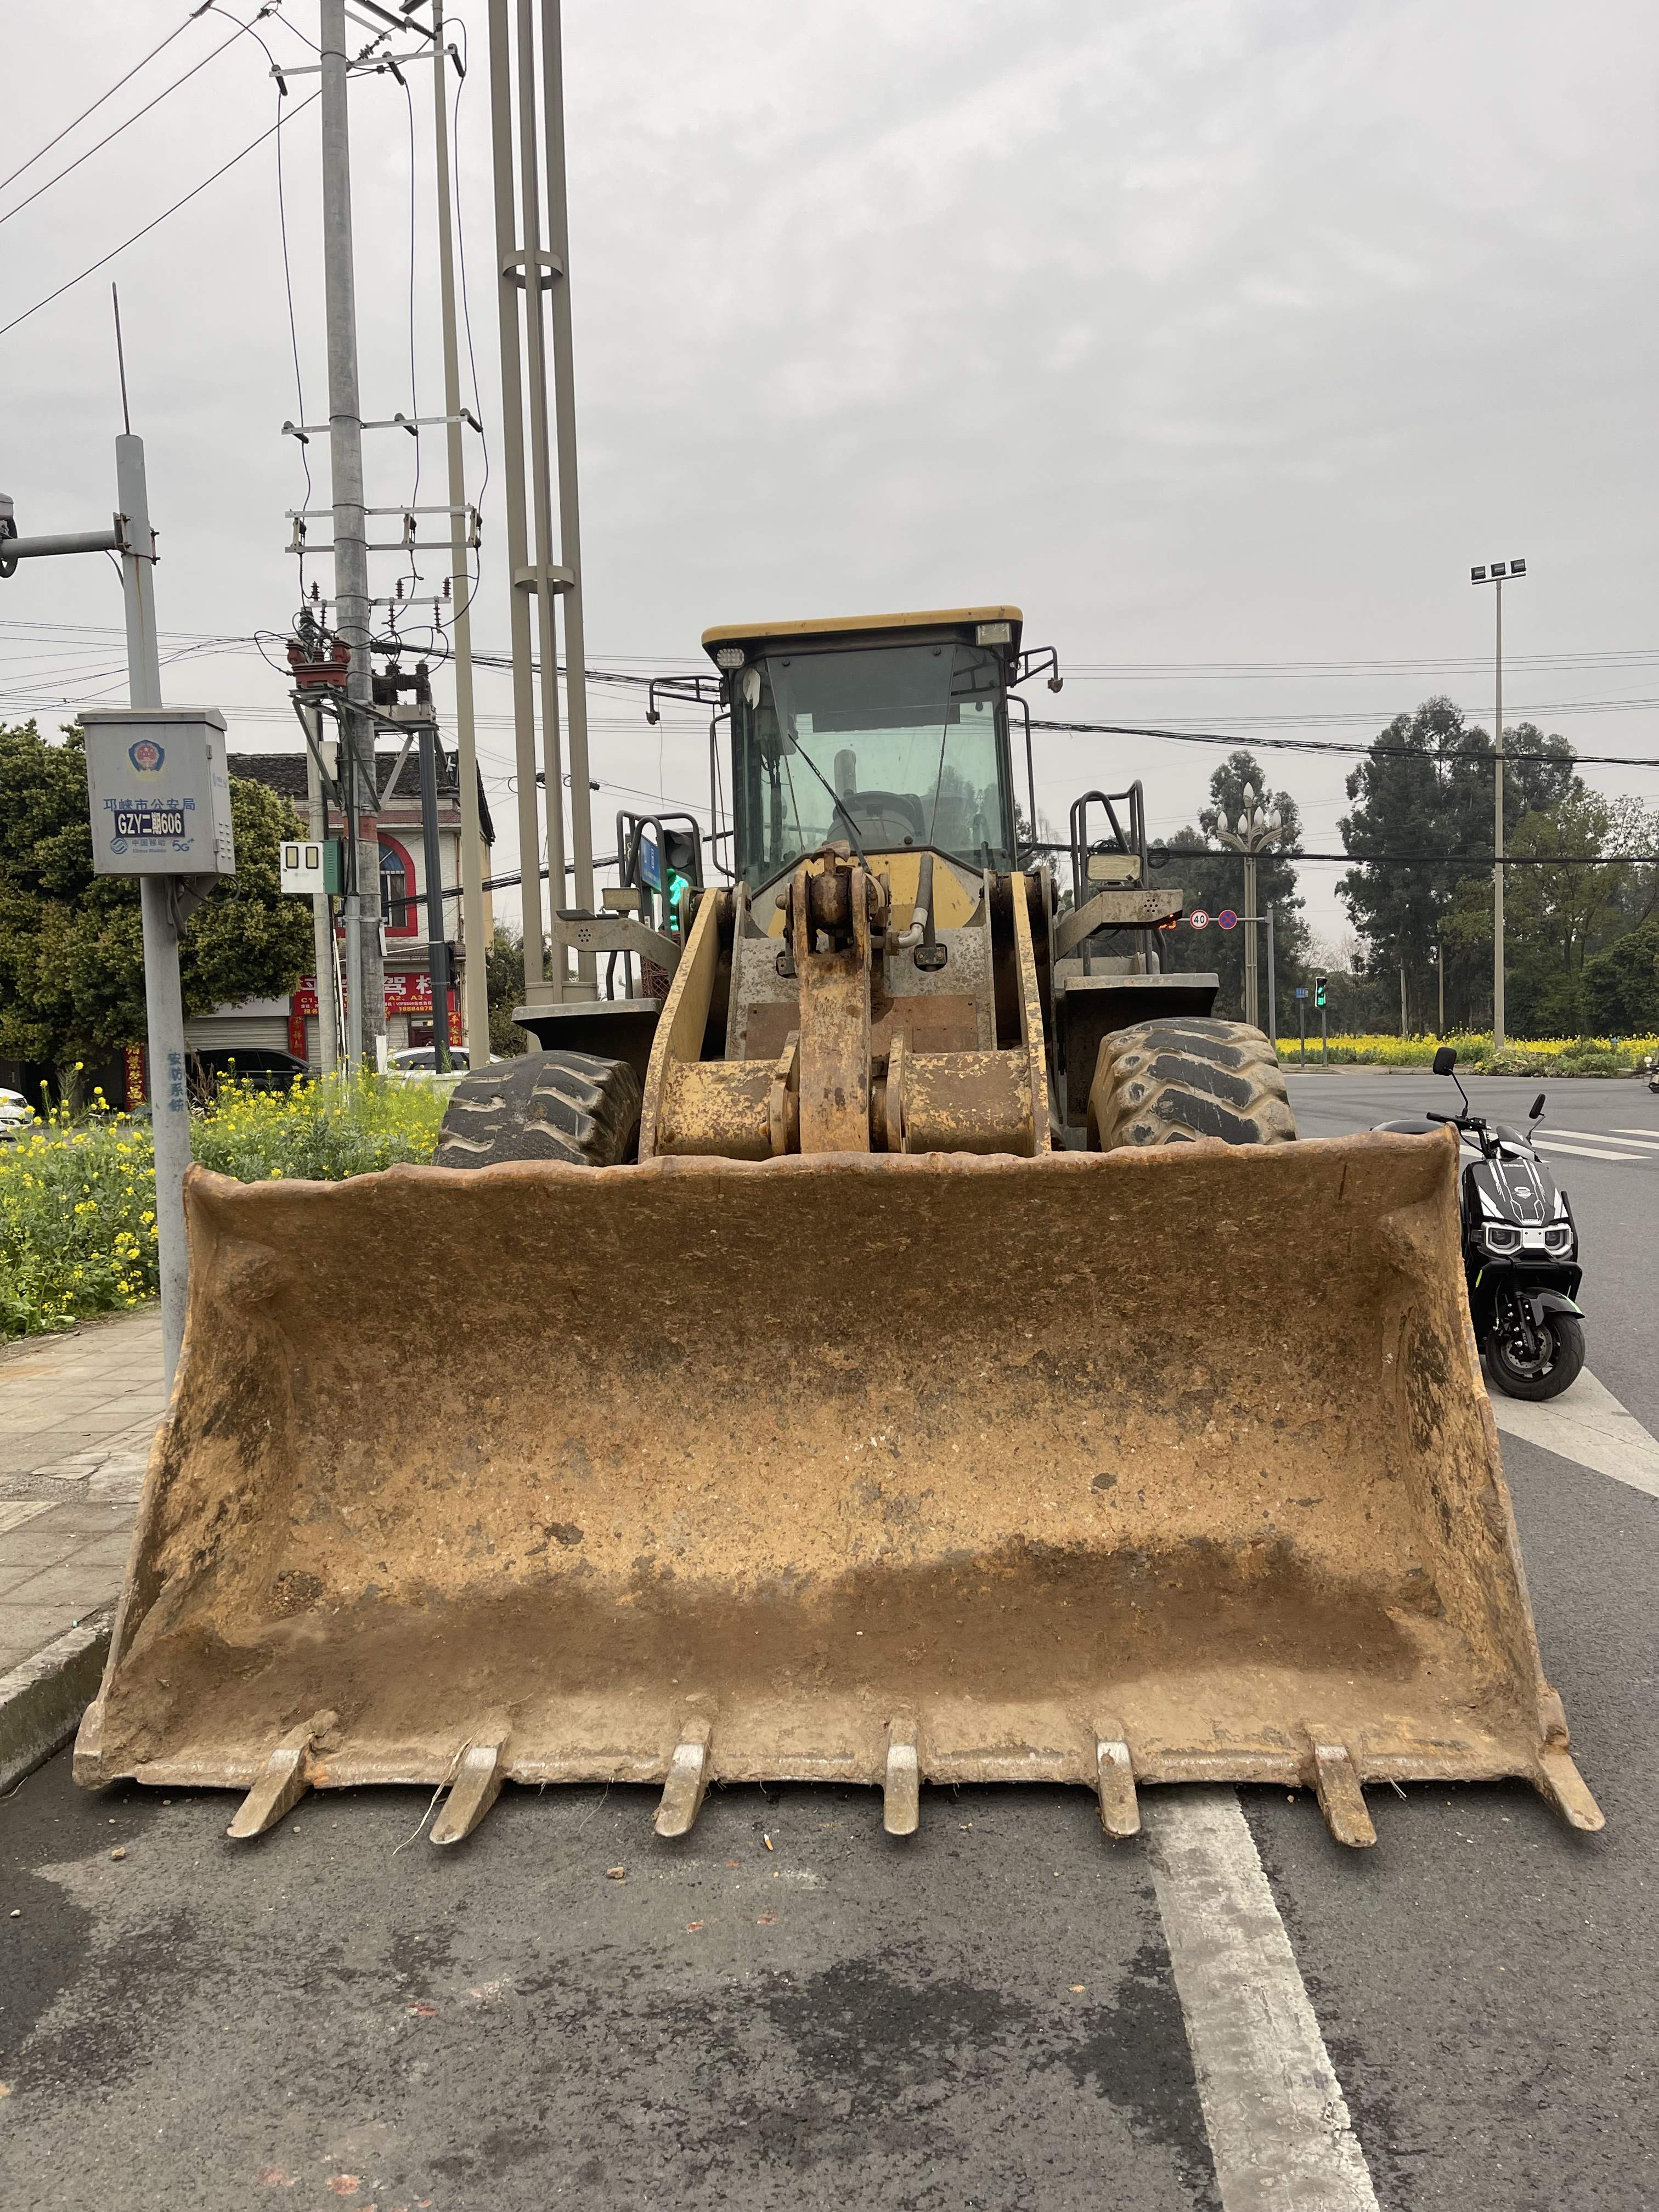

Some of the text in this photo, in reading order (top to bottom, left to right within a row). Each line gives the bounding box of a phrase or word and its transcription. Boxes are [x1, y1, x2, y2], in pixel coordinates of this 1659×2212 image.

[118, 812, 182, 834] GZY二期606
[132, 838, 166, 847] 中国移动
[1194, 915, 1205, 924] 40
